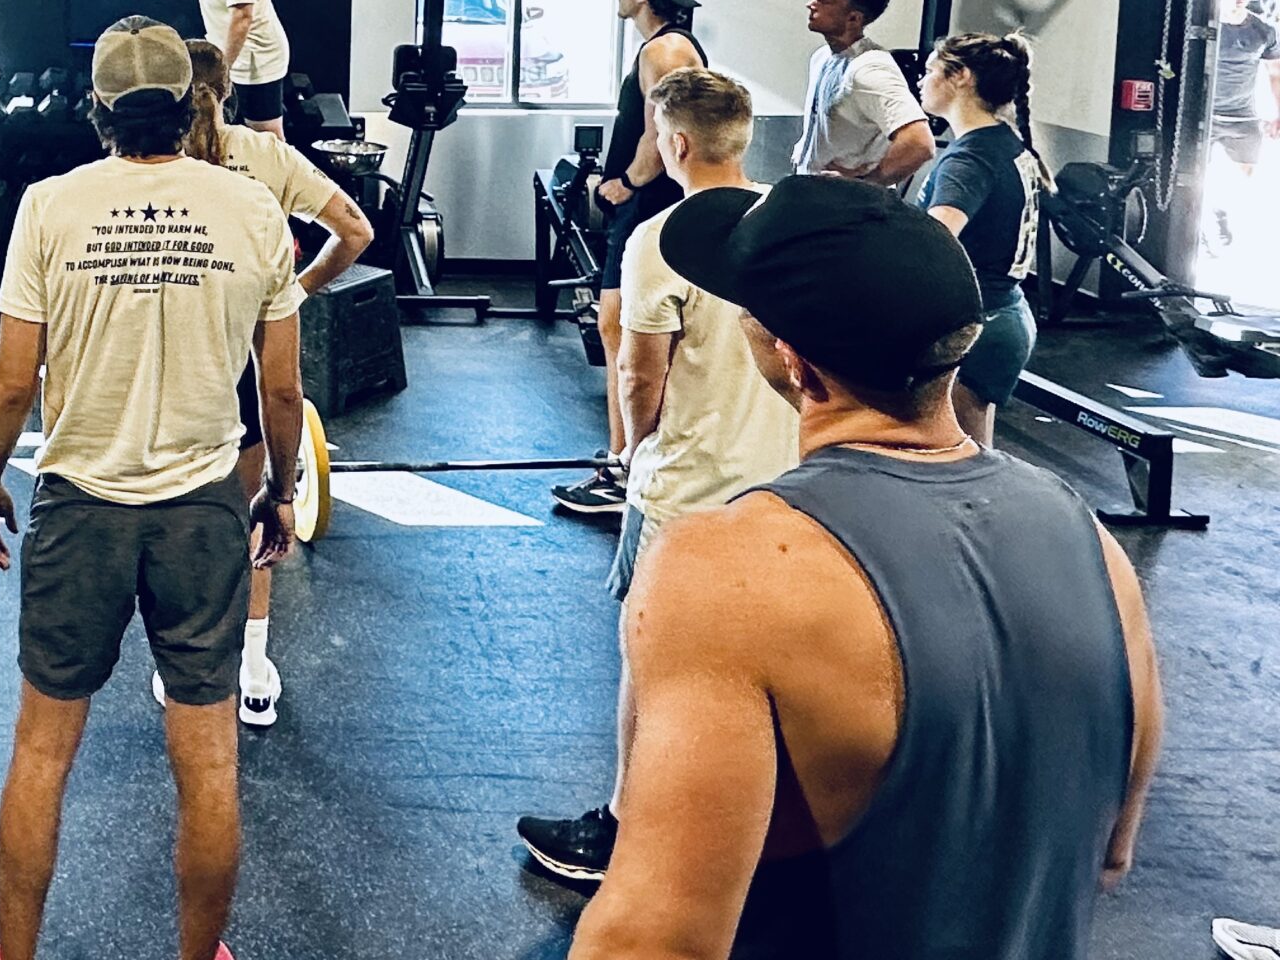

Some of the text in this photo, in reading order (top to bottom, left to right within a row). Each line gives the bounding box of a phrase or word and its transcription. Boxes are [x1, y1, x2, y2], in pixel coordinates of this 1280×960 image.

[114, 224, 154, 234] INTENDED
[156, 224, 166, 234] TO
[168, 224, 192, 234] HARM
[193, 224, 208, 237] ME,
[86, 240, 214, 254] BUT GOD INTENDED IT FOR GOOD
[65, 262, 75, 271] TO
[77, 257, 128, 270] ACCOMPLISH
[129, 257, 151, 267] WHAT
[161, 255, 182, 265] NOW
[183, 257, 209, 269] BEING
[211, 260, 236, 273] DONE,
[94, 275, 108, 286] THE
[110, 273, 138, 286] SAVING
[140, 273, 150, 285] OF
[153, 271, 173, 285] MNY
